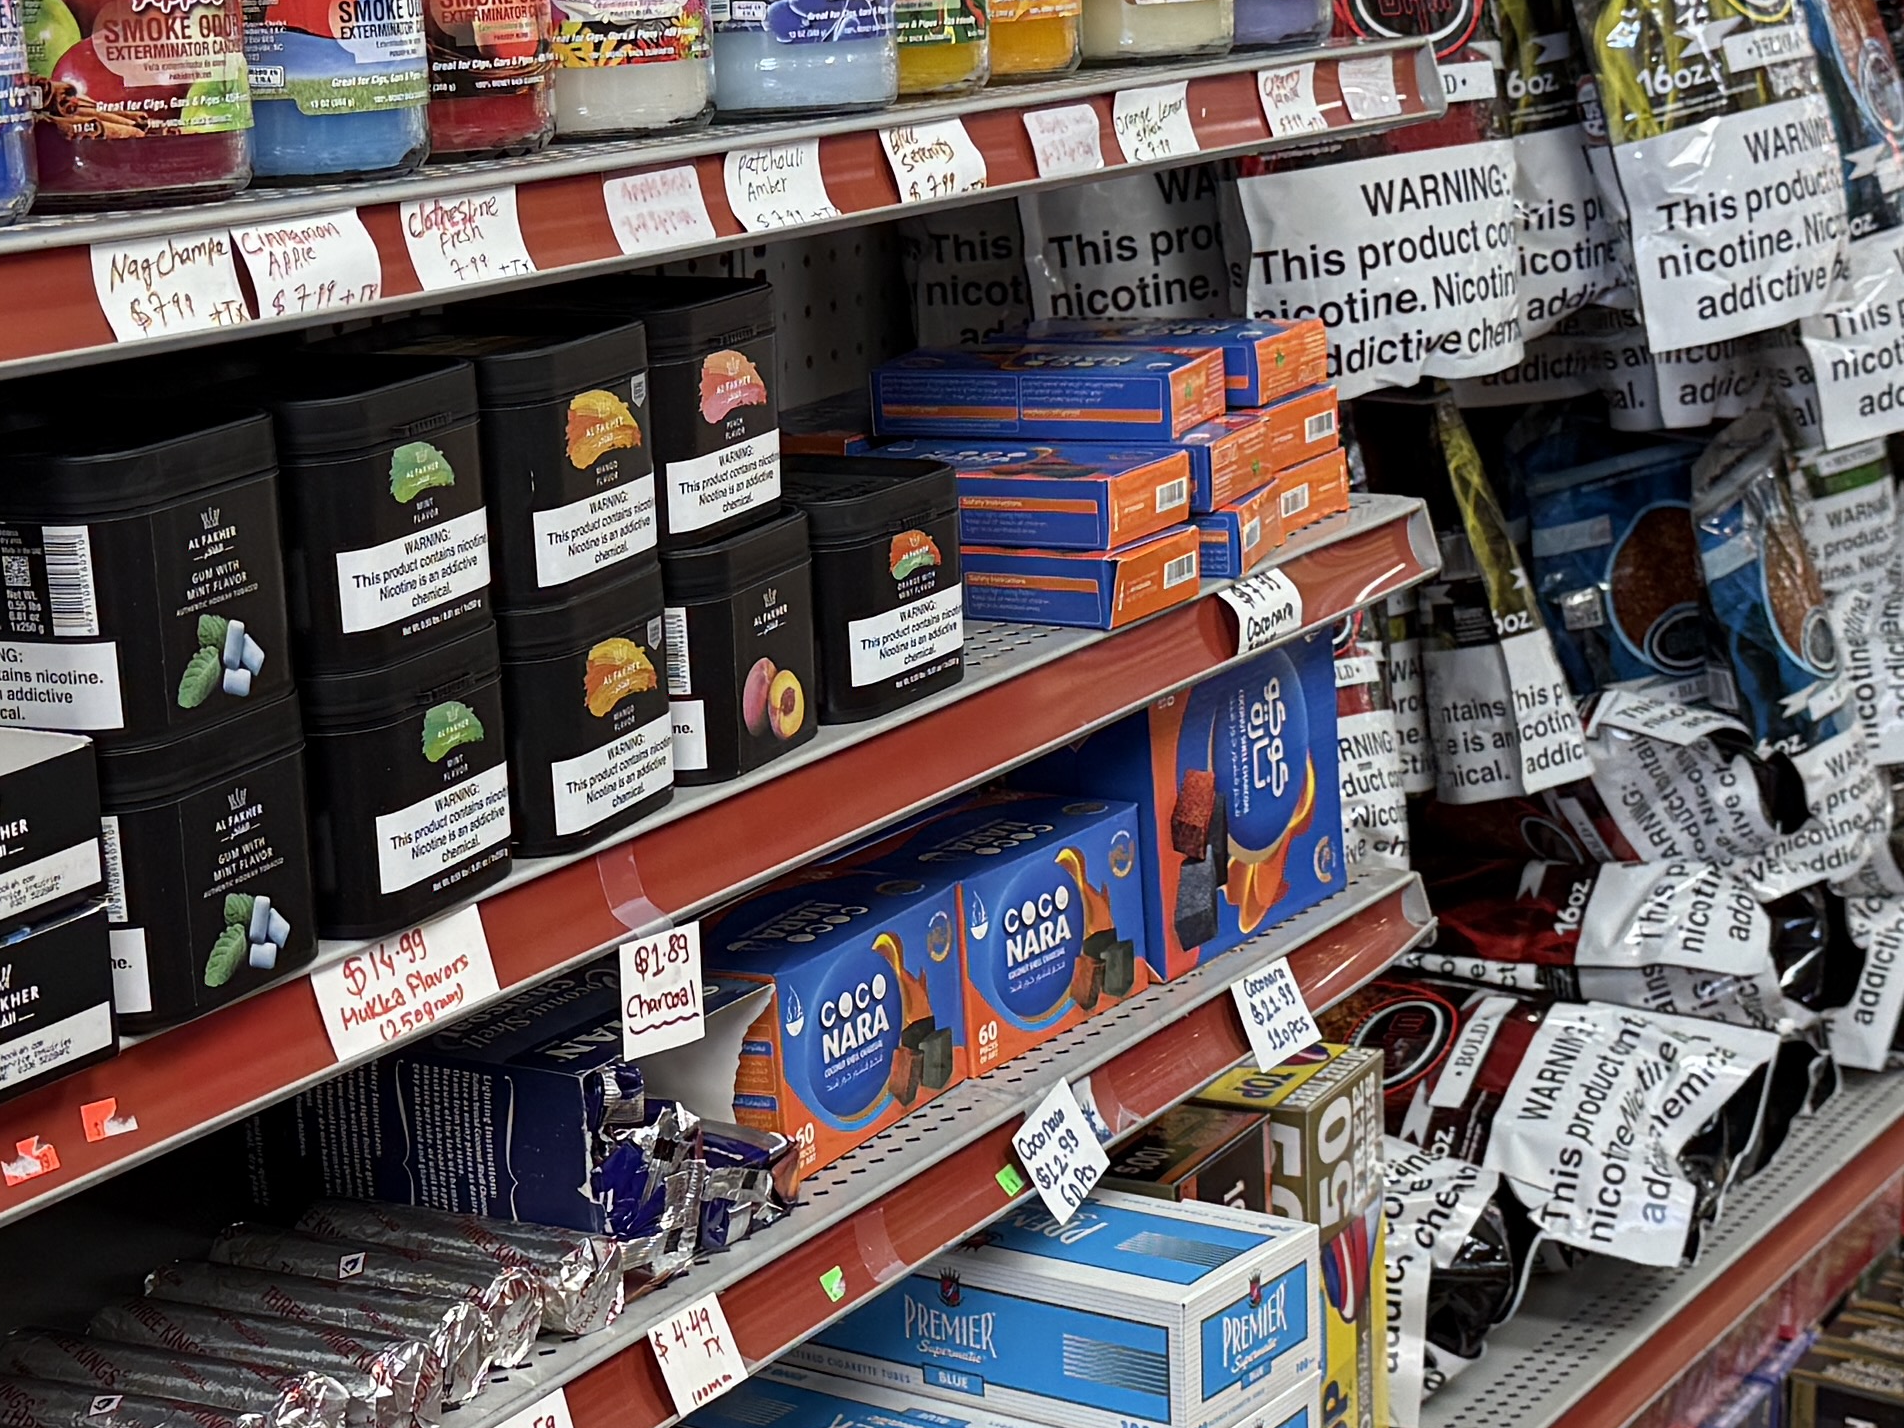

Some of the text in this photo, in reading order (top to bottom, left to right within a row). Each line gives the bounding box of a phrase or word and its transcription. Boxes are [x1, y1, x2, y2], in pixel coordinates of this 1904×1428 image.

[103, 15, 191, 43] SMOKE
[746, 174, 789, 202] Amber
[1361, 166, 1511, 217] WARNING:
[1657, 193, 1738, 231] This
[241, 222, 341, 258] Cinnamon
[1050, 232, 1140, 270] This
[1253, 223, 1479, 285] This product
[1658, 229, 1803, 281] nicotine.
[1050, 267, 1220, 316] nicotine.
[1697, 265, 1827, 320] addictive
[7, 688, 73, 704] addictive
[36, 669, 103, 684] nicotine.
[1003, 884, 1069, 936] COCO
[1554, 878, 1592, 937] 16oz.
[343, 927, 427, 998] $14.99
[634, 933, 690, 980] $1.89
[1005, 921, 1073, 969] NARA
[978, 1021, 998, 1045] 60
[1465, 1023, 1491, 1070] BOLD
[654, 1310, 712, 1364] $4.49
[902, 1292, 996, 1360] PREMIER
[935, 1372, 970, 1392] BLUE
